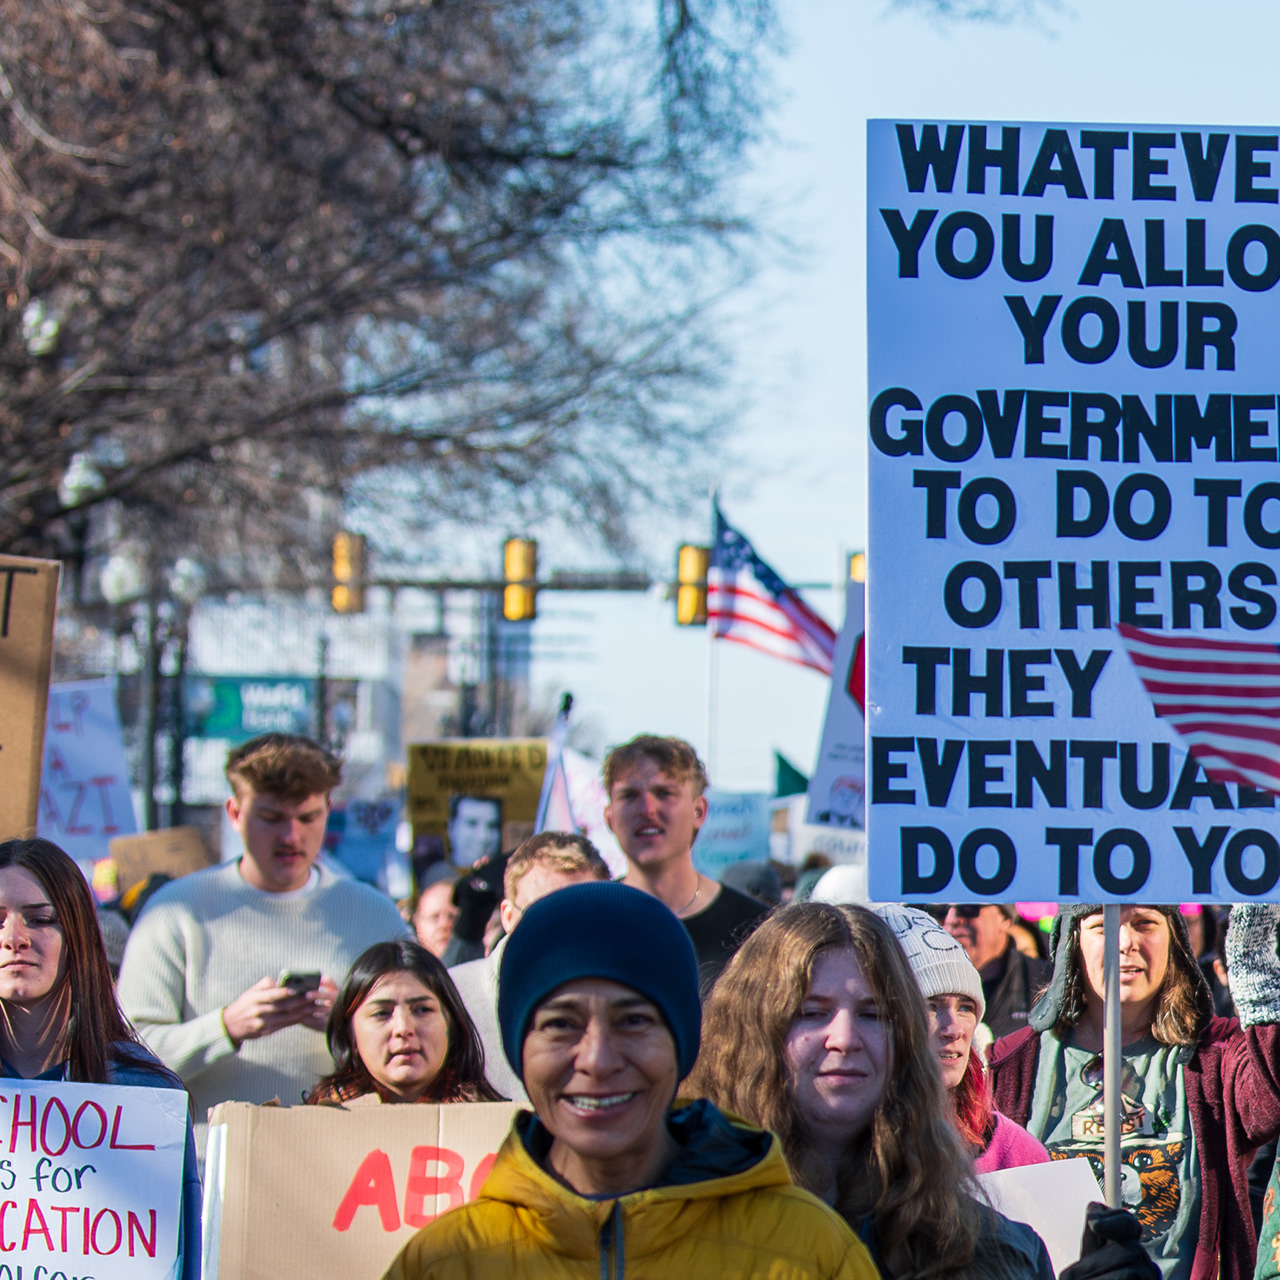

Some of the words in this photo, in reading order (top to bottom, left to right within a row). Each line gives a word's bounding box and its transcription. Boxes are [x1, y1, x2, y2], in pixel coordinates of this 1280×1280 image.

[880, 208, 1054, 282] YOU
[1004, 294, 1238, 371] YOUR
[913, 469, 1016, 545] TO
[1056, 469, 1172, 540] DO
[943, 560, 1278, 630] OTHERS
[902, 646, 1112, 718] THEY
[901, 826, 1017, 896] DO
[1045, 826, 1151, 896] TO
[0, 1094, 156, 1157] HOOL
[30, 1156, 98, 1194] for
